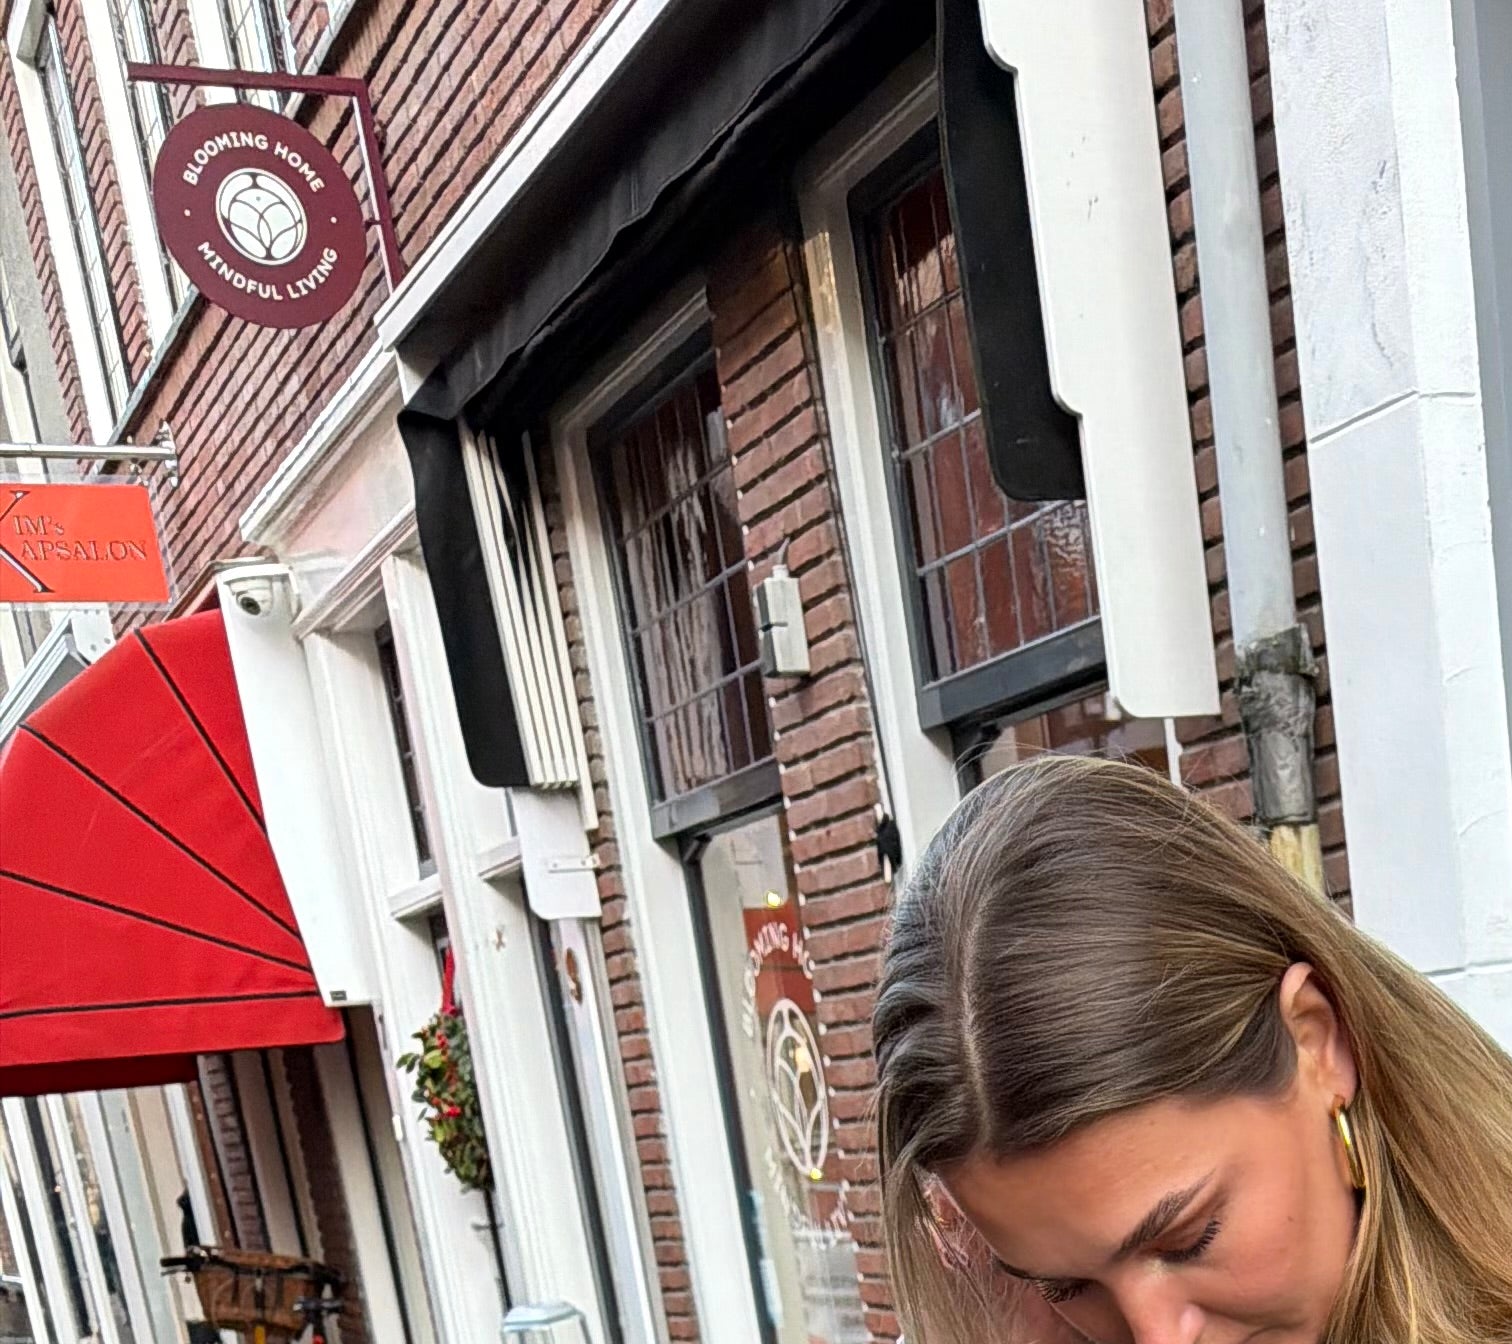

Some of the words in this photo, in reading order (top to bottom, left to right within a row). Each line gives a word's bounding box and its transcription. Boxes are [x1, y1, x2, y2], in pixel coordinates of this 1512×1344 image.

[183, 131, 268, 186] BLOOMING
[274, 142, 325, 192] HOME
[197, 241, 283, 300] MINDFUL
[286, 247, 338, 299] LIVING
